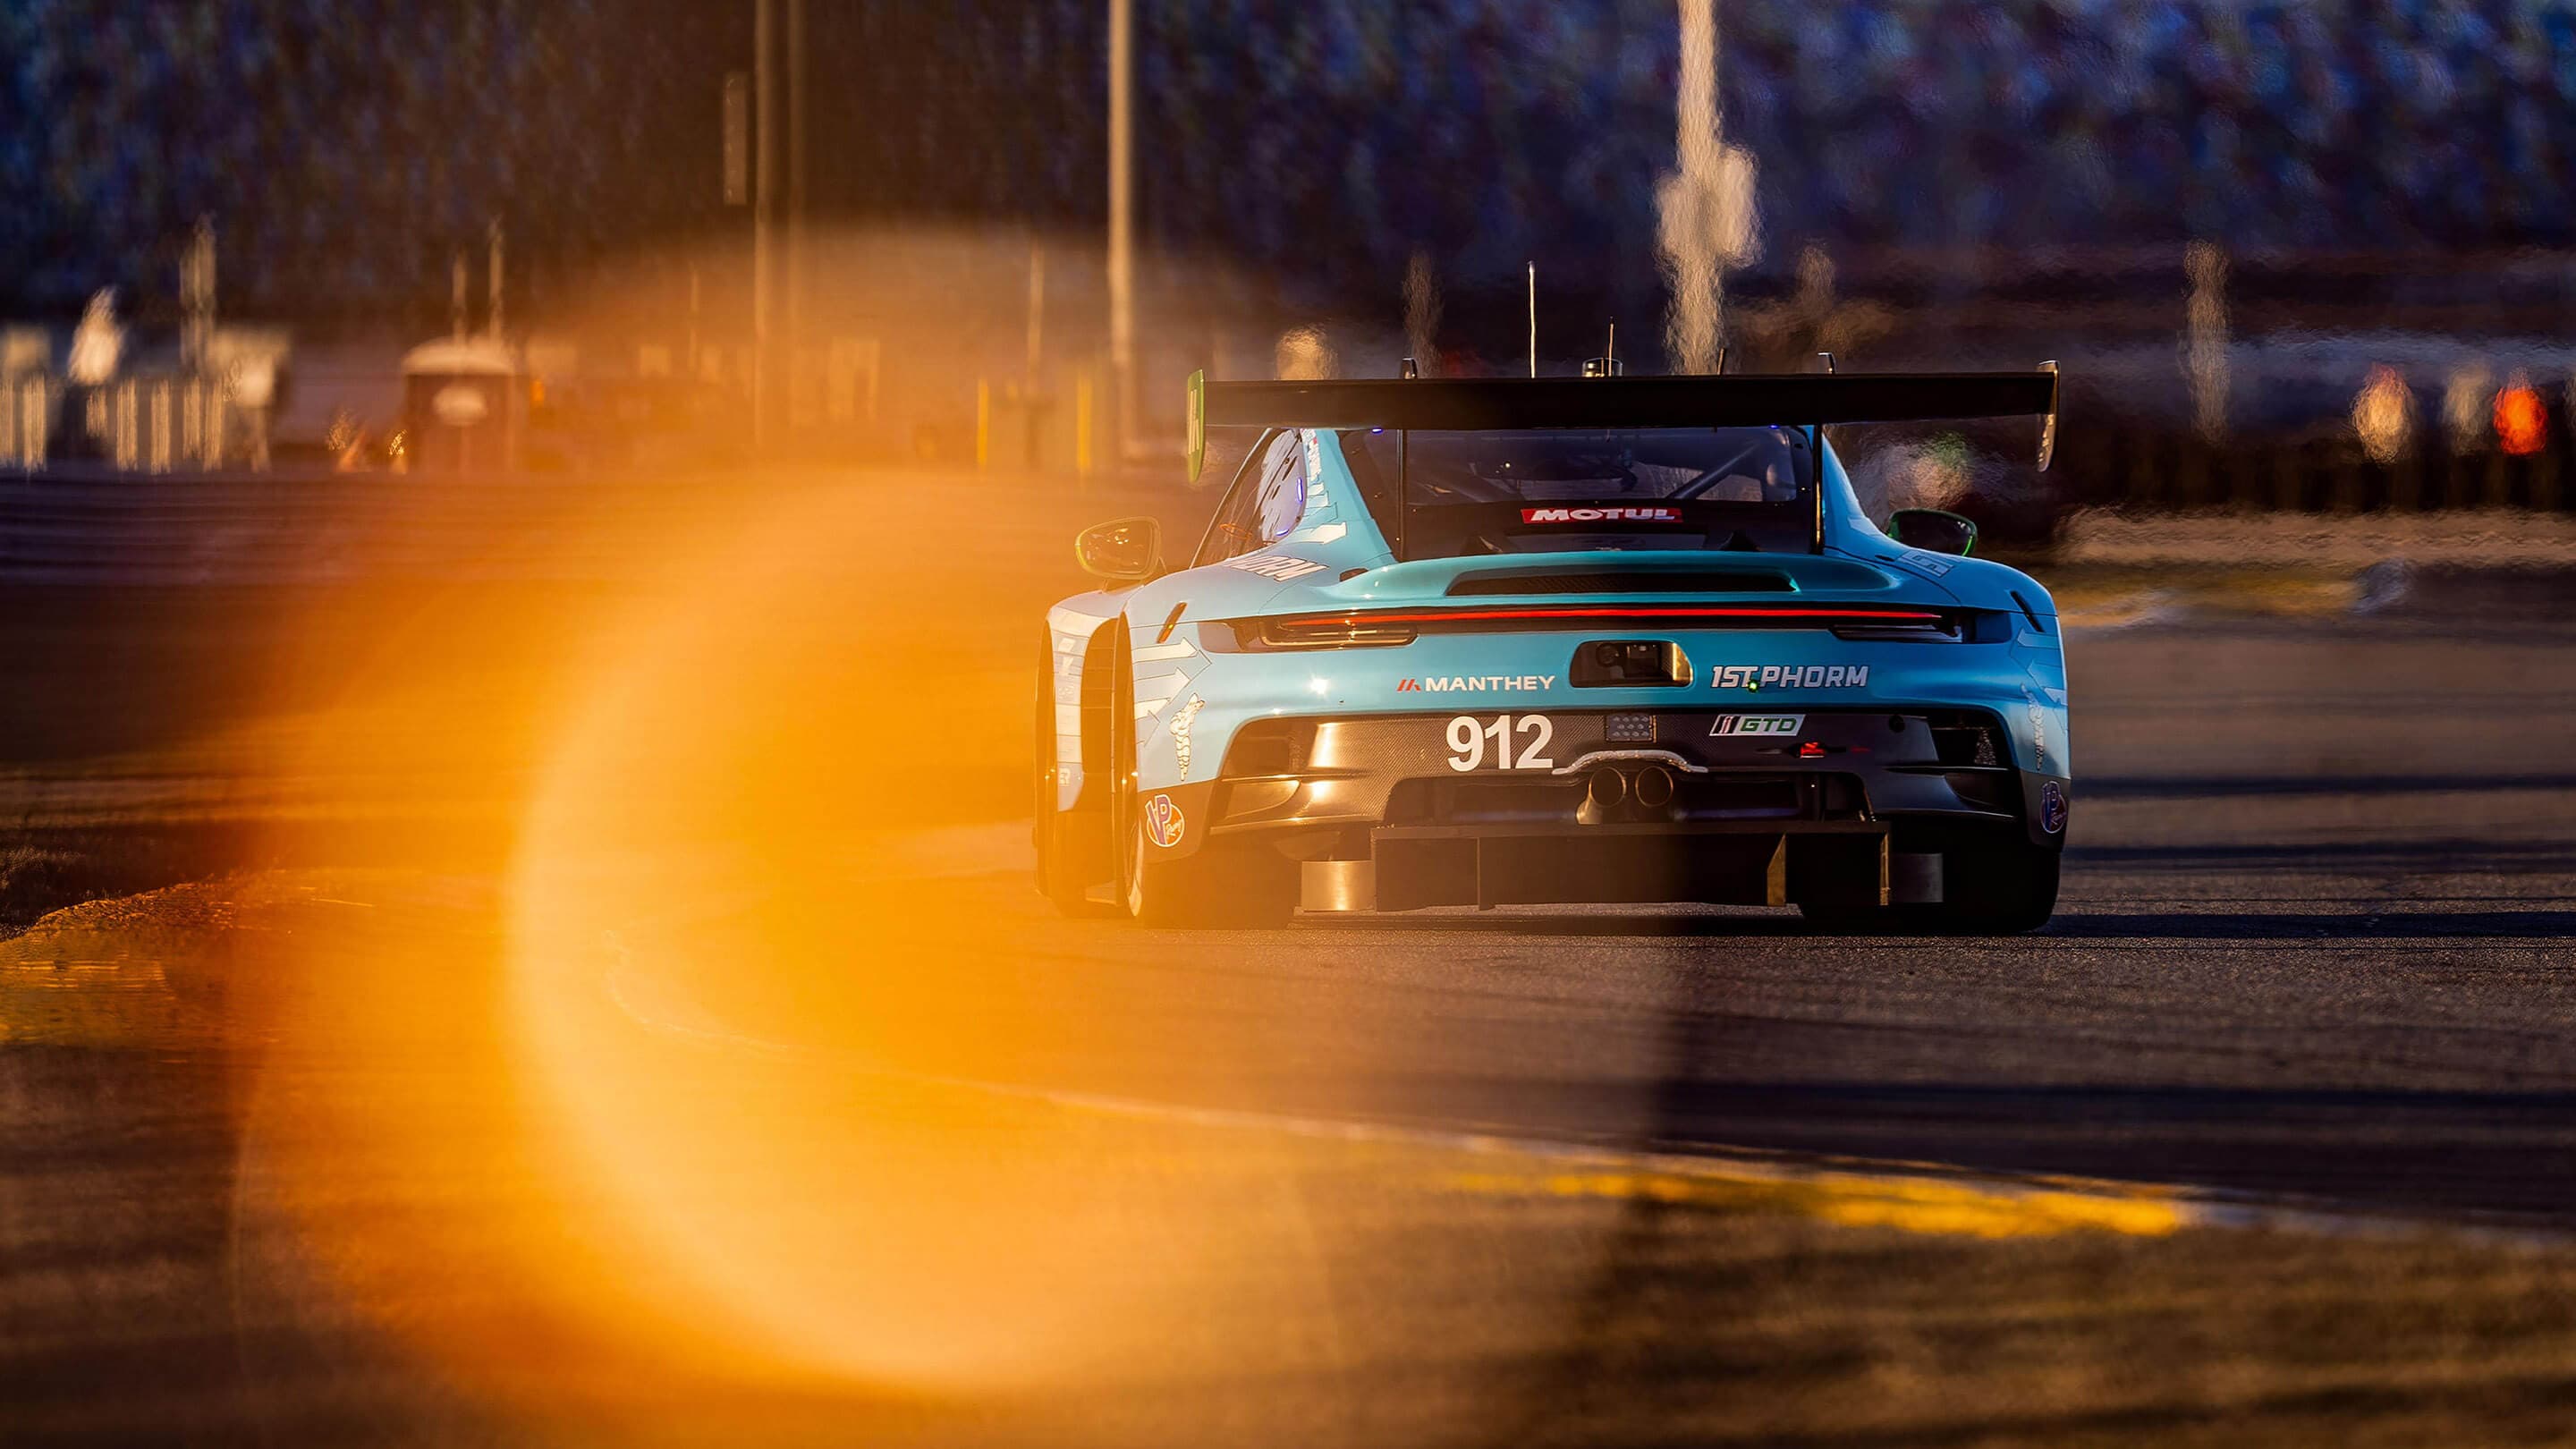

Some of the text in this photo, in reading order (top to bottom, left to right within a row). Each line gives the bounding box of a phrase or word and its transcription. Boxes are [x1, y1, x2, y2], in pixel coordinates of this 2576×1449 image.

[1530, 508, 1675, 521] MOTUL
[1222, 554, 1331, 583] HORM
[1425, 675, 1556, 692] MANTHEY
[1711, 665, 1869, 688] 1ST PHORM
[1740, 717, 1798, 732] GTD
[1445, 714, 1554, 773] 912
[1145, 793, 1173, 846] VP
